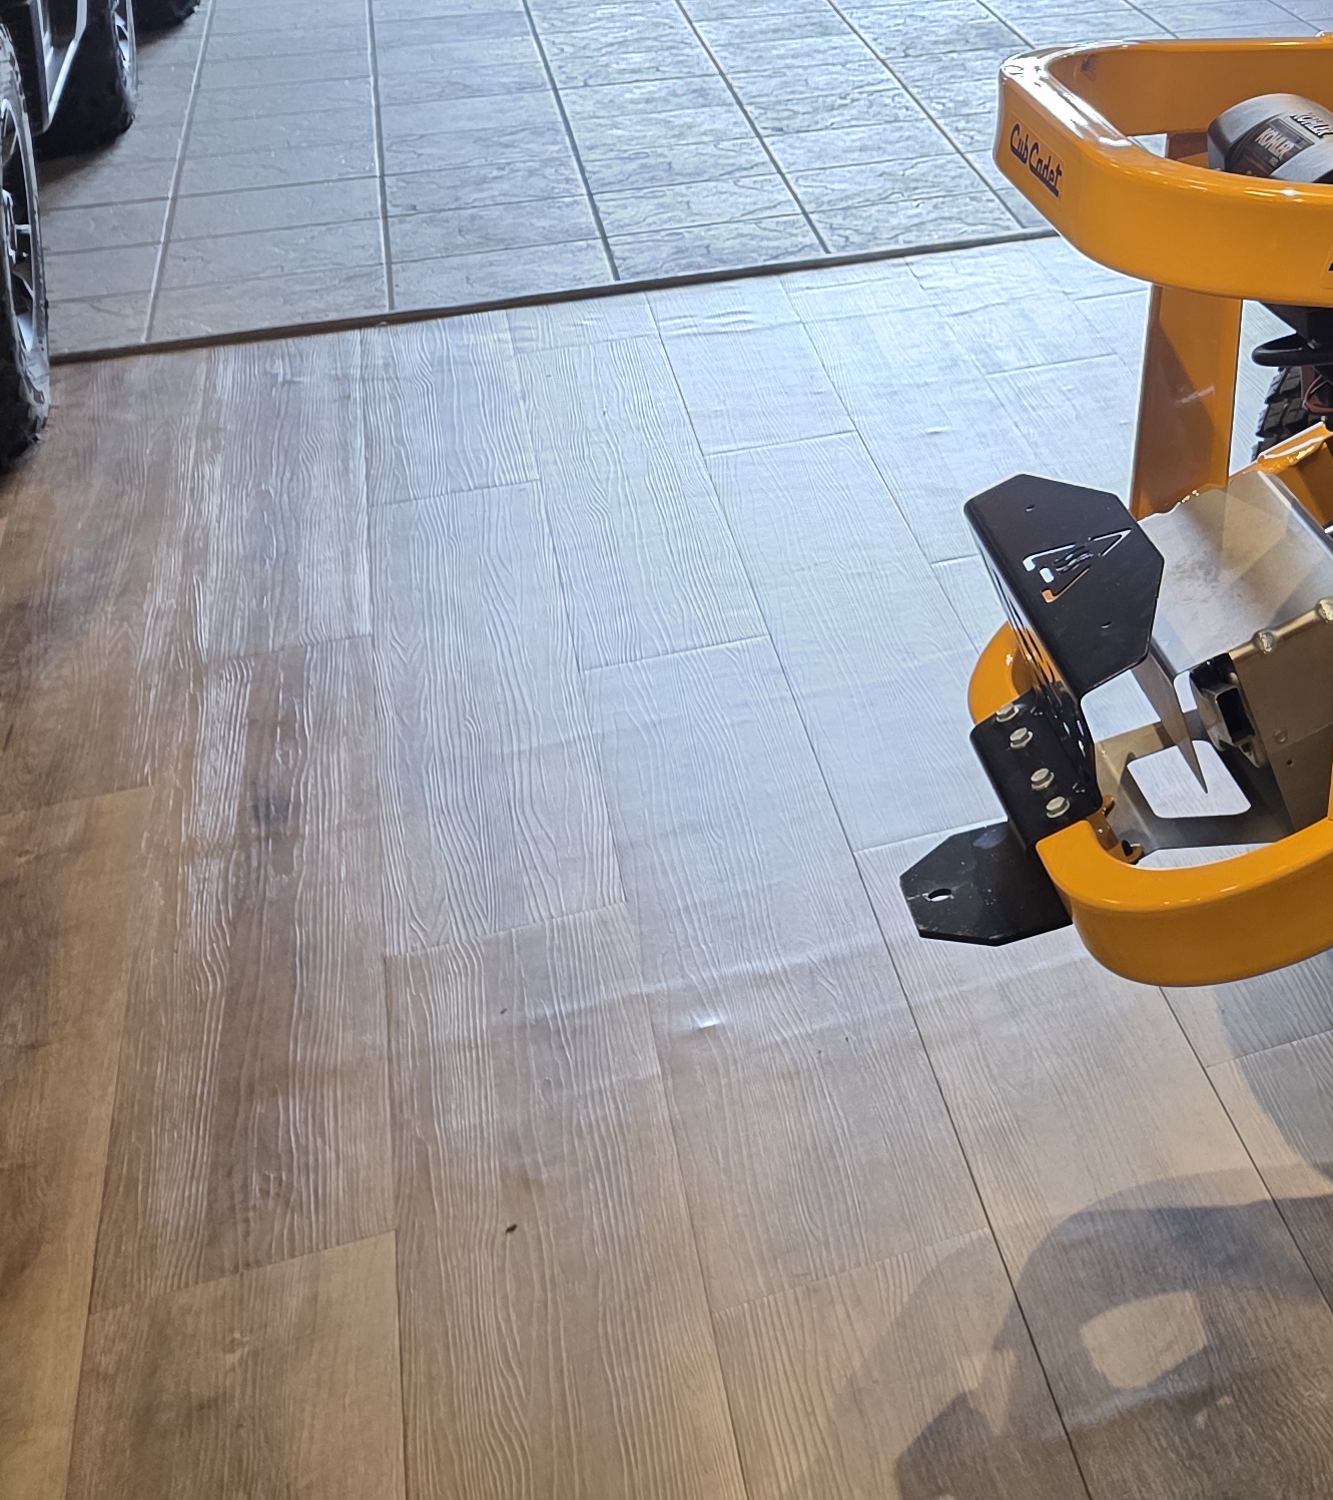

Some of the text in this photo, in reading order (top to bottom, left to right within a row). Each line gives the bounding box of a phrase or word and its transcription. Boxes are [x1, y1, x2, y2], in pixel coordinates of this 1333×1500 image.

[1010, 123, 1063, 198] Cub Cadet
[1255, 127, 1295, 161] KOHLER
